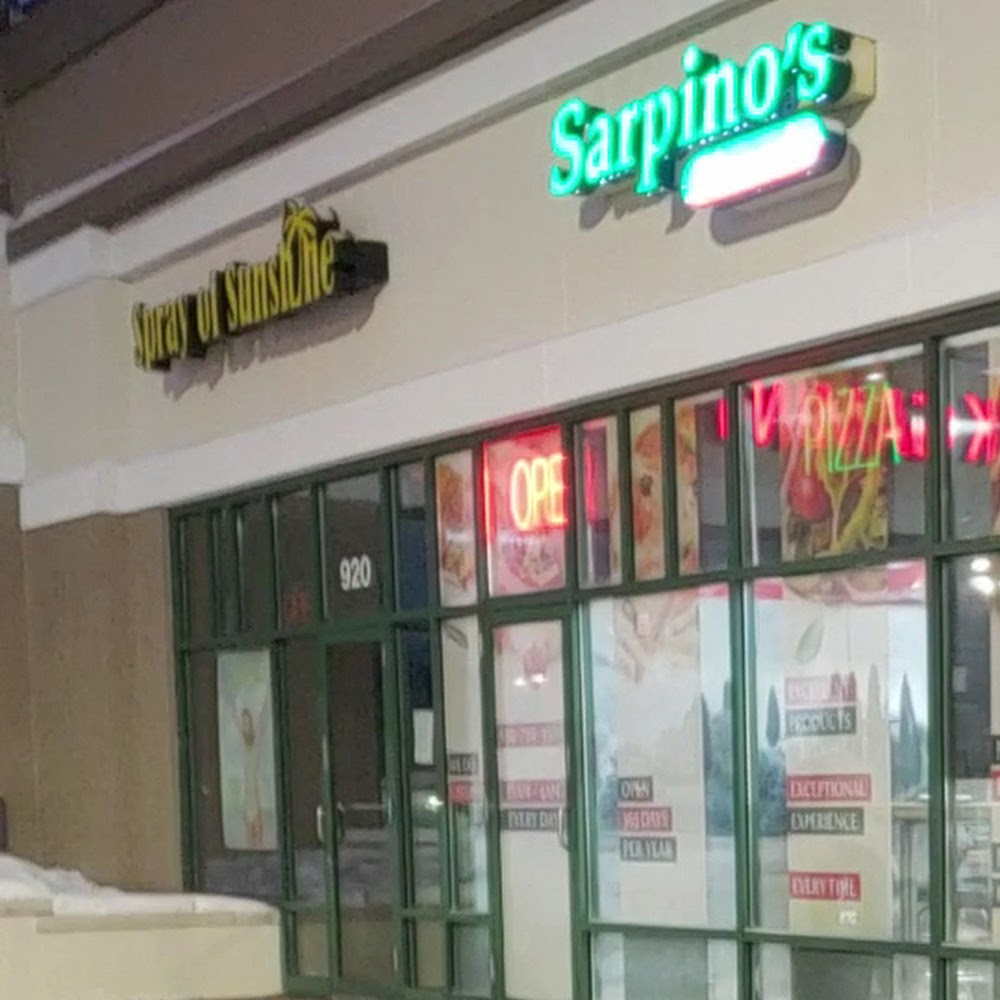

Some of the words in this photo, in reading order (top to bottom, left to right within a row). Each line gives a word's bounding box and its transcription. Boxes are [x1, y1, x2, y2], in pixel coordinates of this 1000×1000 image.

[550, 21, 832, 196] Sarpino's
[132, 301, 188, 371] Spray
[196, 268, 220, 342] of
[510, 452, 569, 531] OPE
[340, 554, 371, 591] 920
[789, 779, 867, 799] EXCEPTIONAL
[790, 811, 859, 832] EXPERIENCE
[792, 876, 826, 896] EVERY
